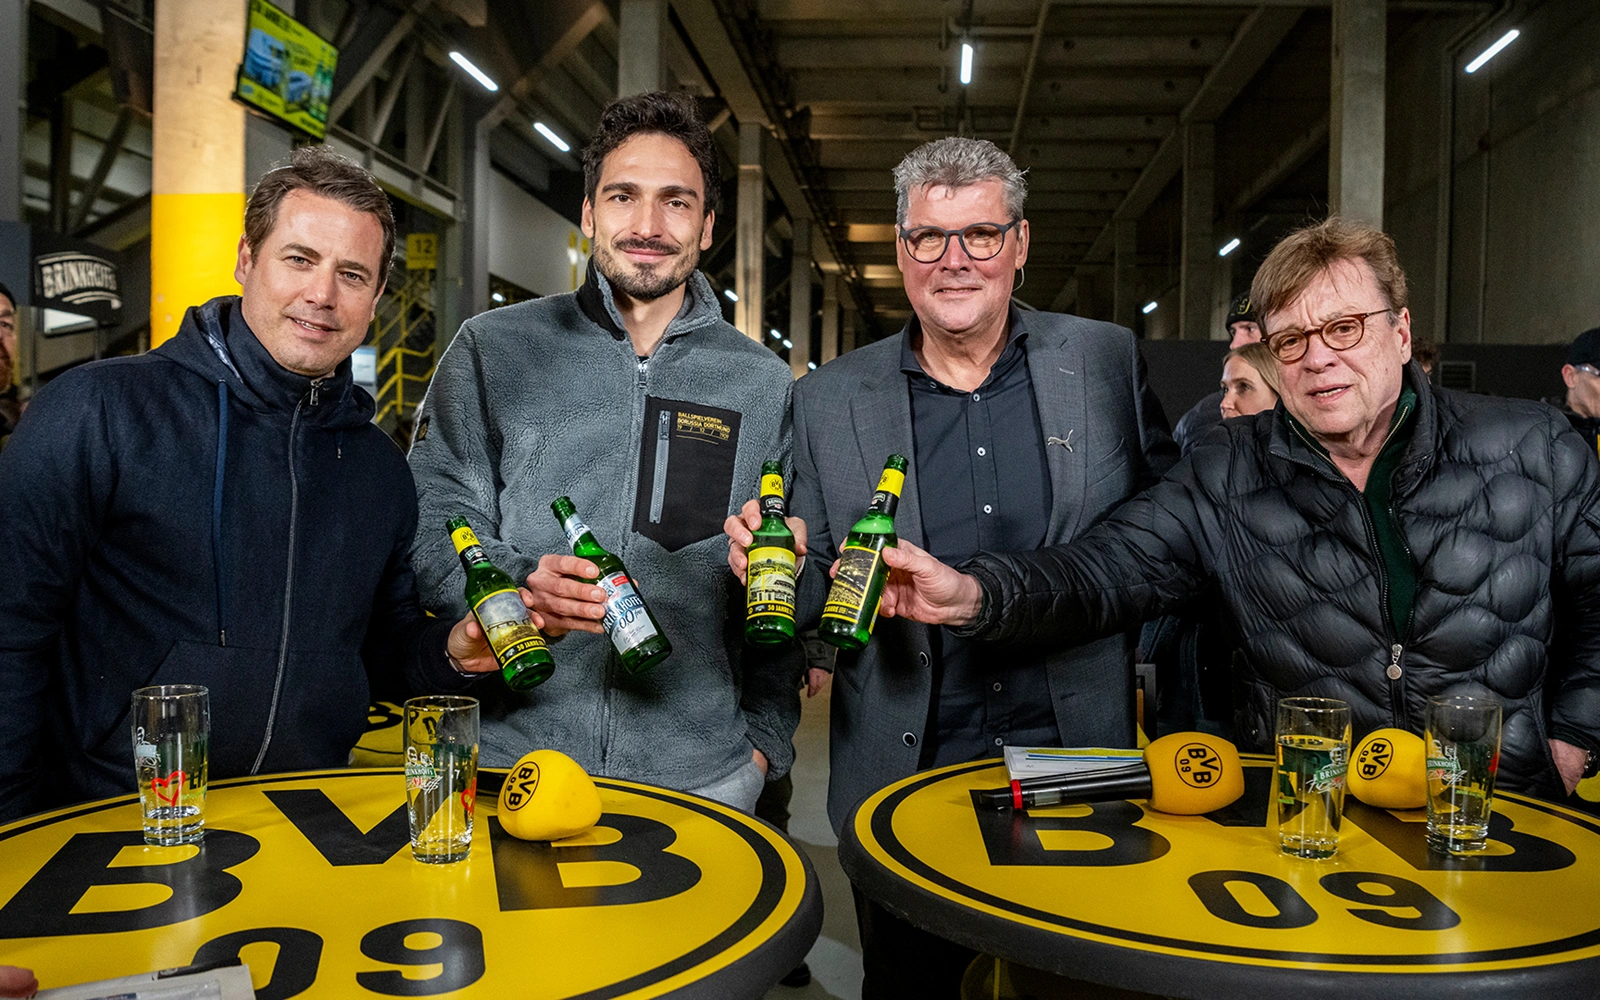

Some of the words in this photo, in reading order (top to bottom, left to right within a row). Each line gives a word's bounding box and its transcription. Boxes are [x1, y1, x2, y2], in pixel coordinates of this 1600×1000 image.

[416, 239, 433, 254] 12
[677, 411, 722, 424] BALLSPIELVEREIN
[677, 418, 703, 428] BORUSSIA
[703, 422, 731, 434] DORTMUND
[516, 643, 525, 651] 50
[1179, 758, 1192, 773] 09
[1187, 747, 1219, 784] BVB
[1362, 742, 1389, 776] BVB
[508, 767, 536, 806] BVB
[1187, 869, 1462, 931] 09
